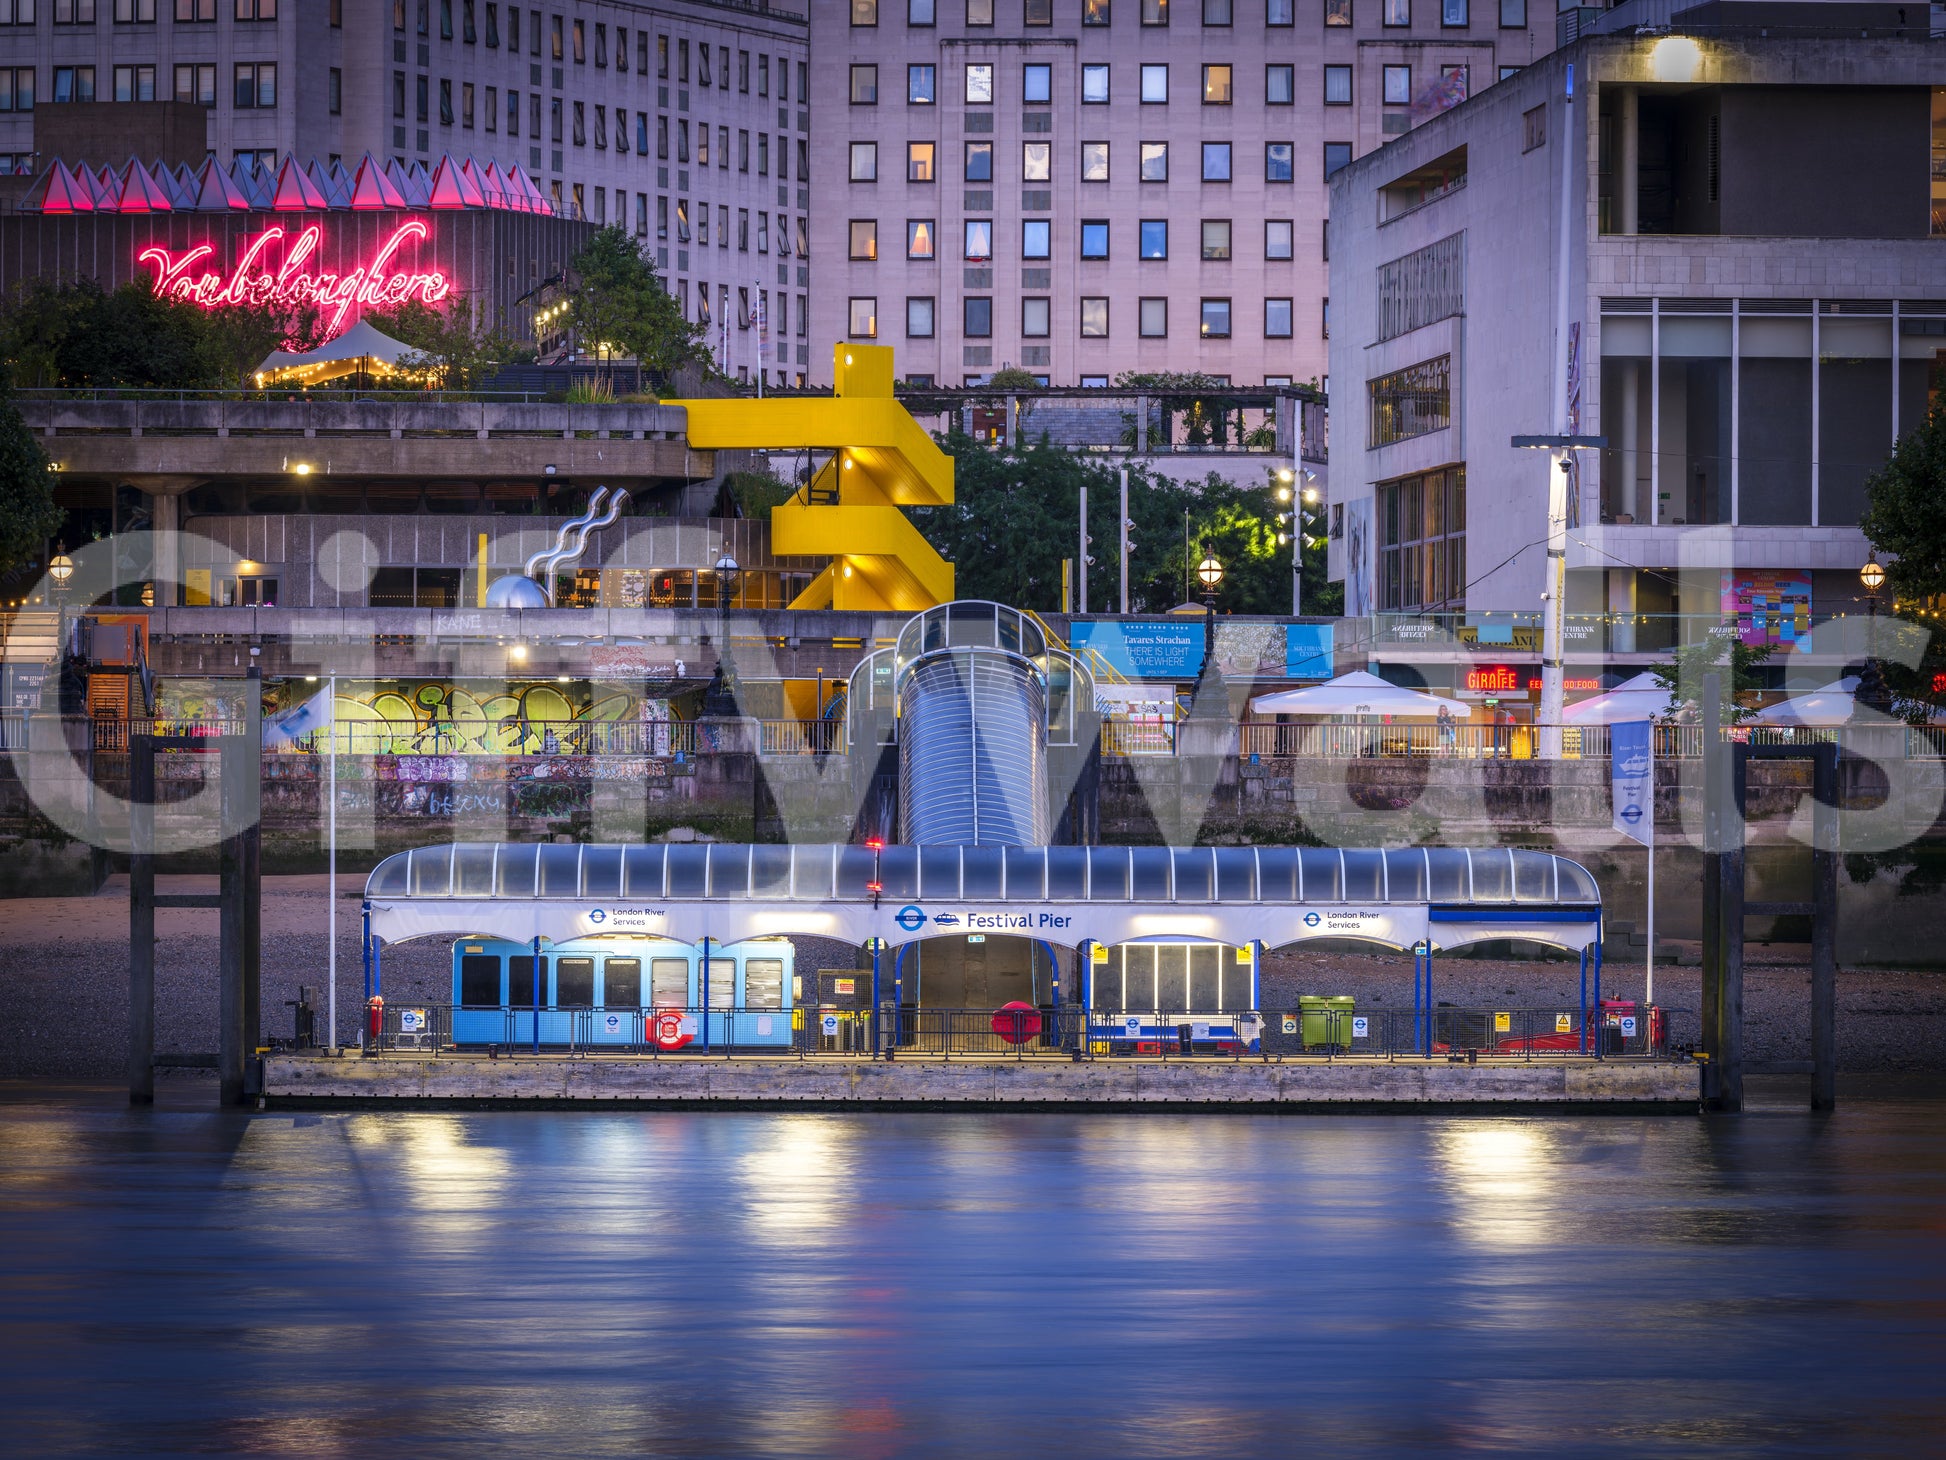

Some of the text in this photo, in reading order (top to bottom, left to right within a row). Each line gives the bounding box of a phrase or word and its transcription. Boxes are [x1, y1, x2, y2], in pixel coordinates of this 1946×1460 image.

[139, 221, 450, 353] You belong here
[1123, 635, 1191, 645] Tavares Strachan
[1124, 646, 1190, 656] THERE IS LIGHT
[1129, 656, 1185, 666] SOMEWHERE
[1468, 668, 1516, 689] GIRAFFE
[1577, 680, 1599, 689] FOOD
[612, 908, 643, 916] London
[644, 908, 666, 916] River
[1327, 911, 1380, 919] London River
[613, 918, 646, 926] Services
[967, 912, 1072, 928] Festival Pier
[1327, 921, 1361, 929] Services
